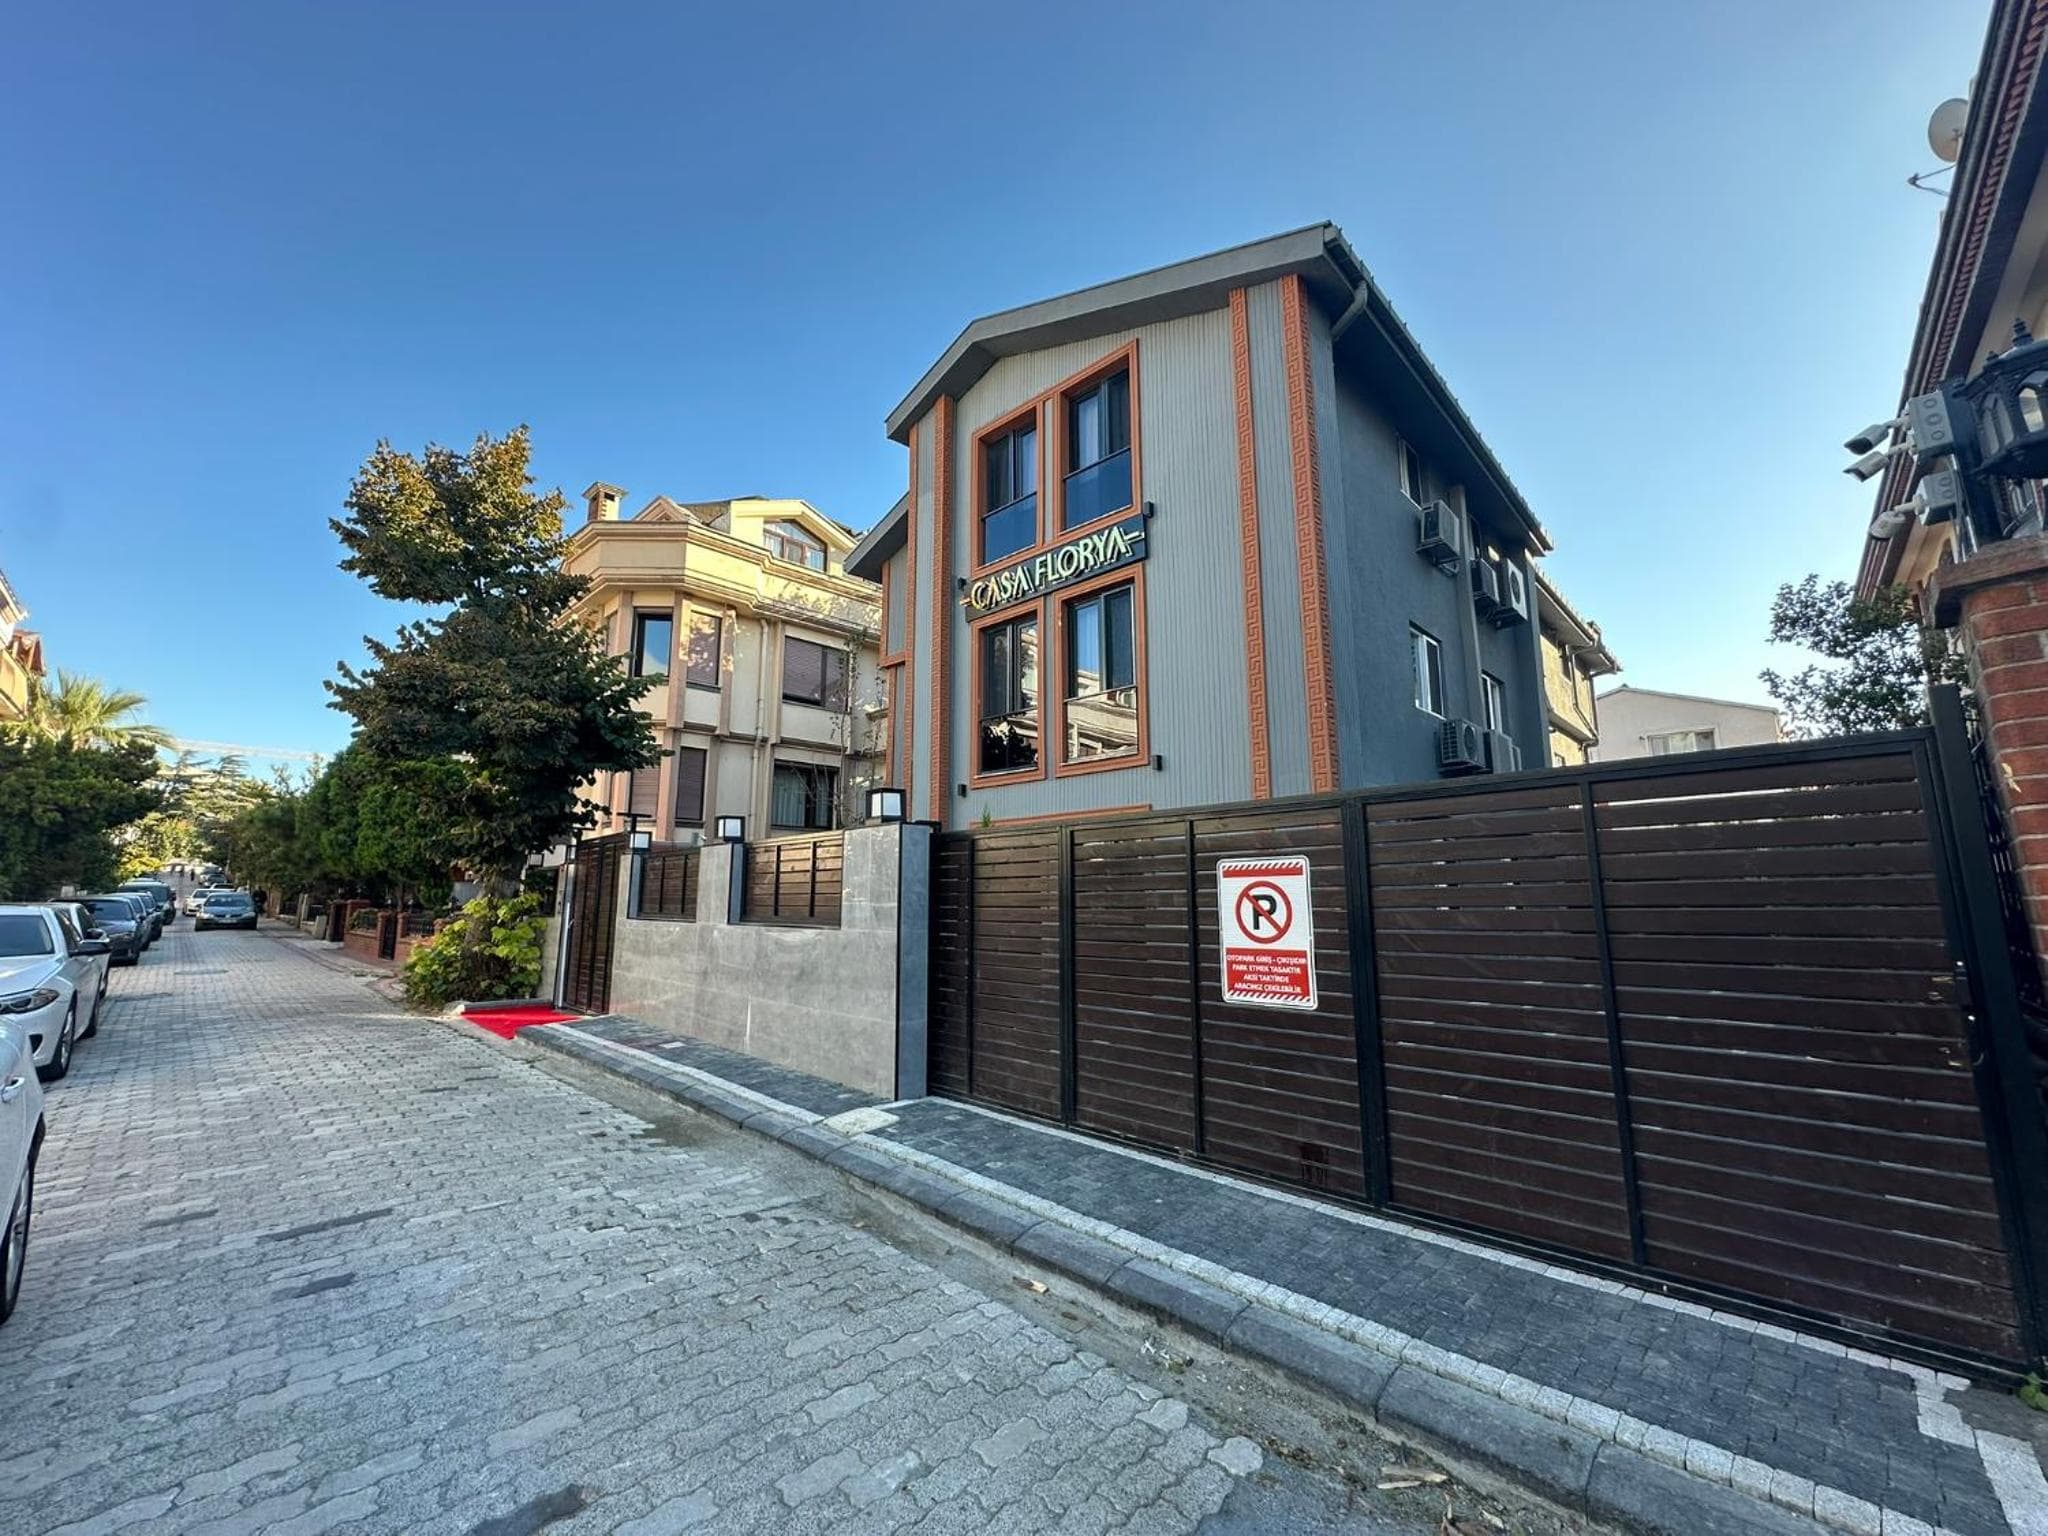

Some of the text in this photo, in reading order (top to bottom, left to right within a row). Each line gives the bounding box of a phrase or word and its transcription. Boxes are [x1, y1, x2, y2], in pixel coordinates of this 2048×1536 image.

[971, 526, 1130, 610] CASA FLORYA
[1252, 894, 1277, 930] P
[1226, 954, 1255, 962] OTOPARK
[1270, 966, 1301, 974] YASAKTIR
